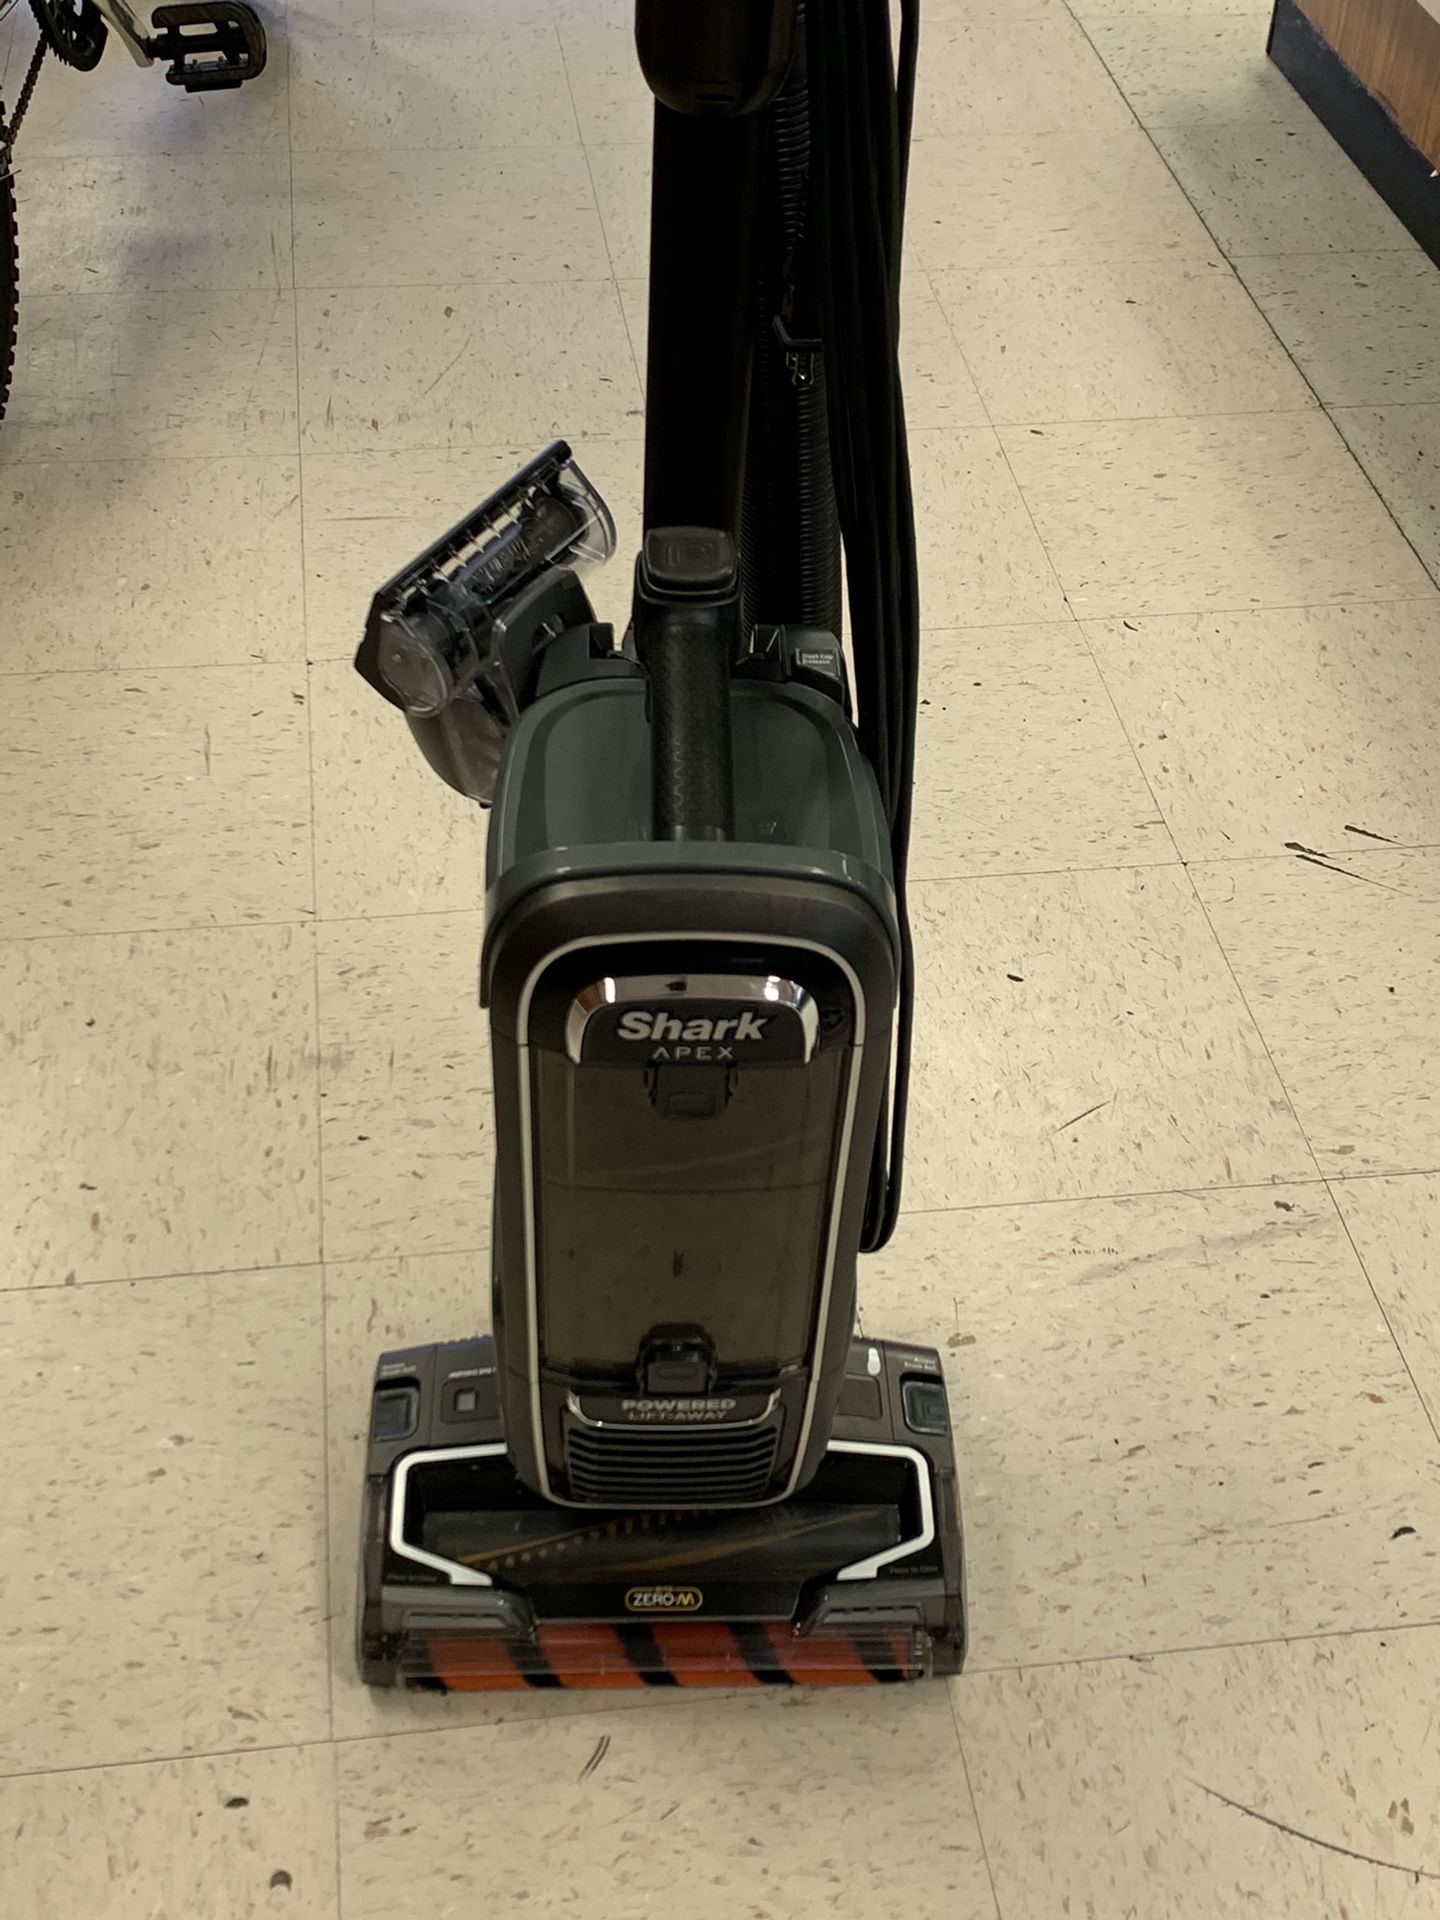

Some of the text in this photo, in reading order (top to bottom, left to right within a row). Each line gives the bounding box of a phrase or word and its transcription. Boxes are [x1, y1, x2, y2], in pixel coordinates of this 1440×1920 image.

[616, 1011, 769, 1041] Shark
[652, 1046, 734, 1060] APEX
[621, 1399, 737, 1411] POWERED
